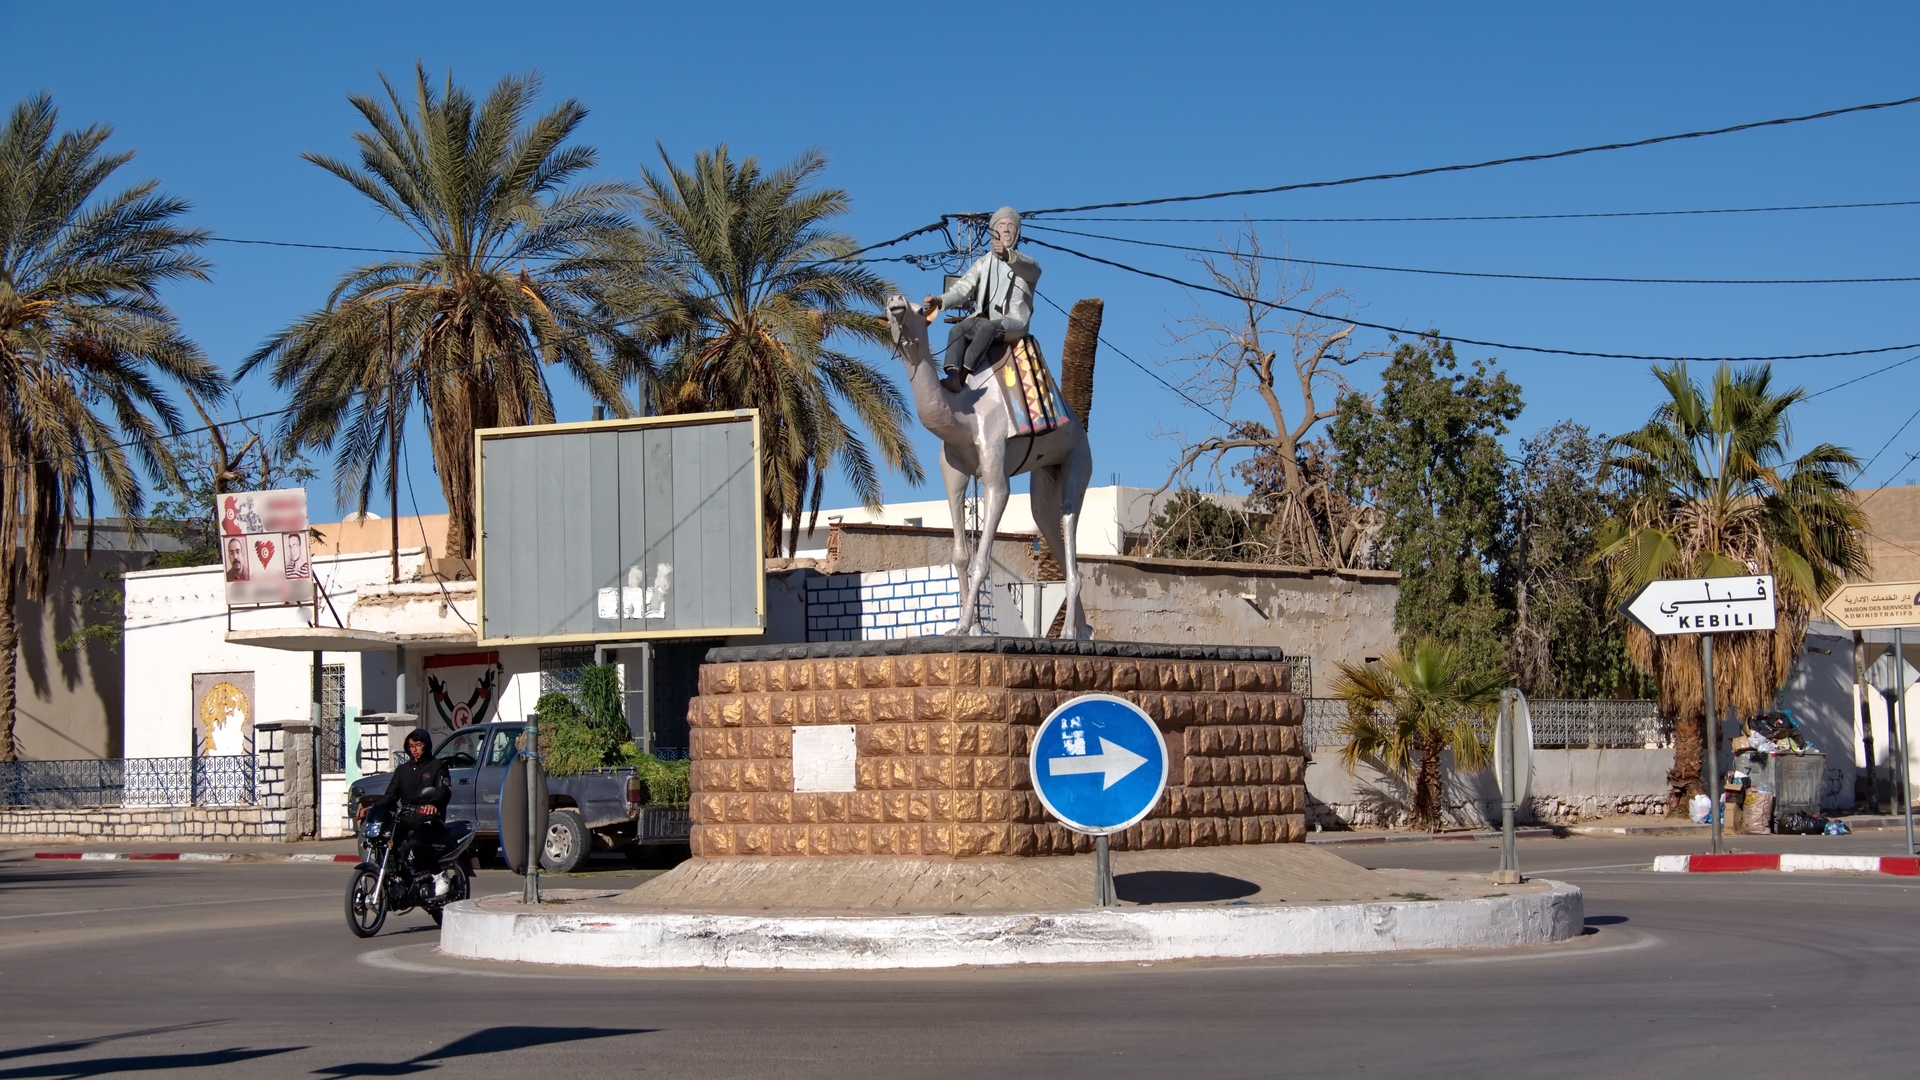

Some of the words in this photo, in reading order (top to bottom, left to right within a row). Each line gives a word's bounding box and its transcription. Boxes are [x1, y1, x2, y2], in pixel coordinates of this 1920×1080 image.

[1871, 594, 1898, 602] الخدمات
[1901, 594, 1911, 602] دار
[1844, 611, 1913, 619] ADMINISTRATIFS
[1679, 613, 1753, 628] KEBILI
